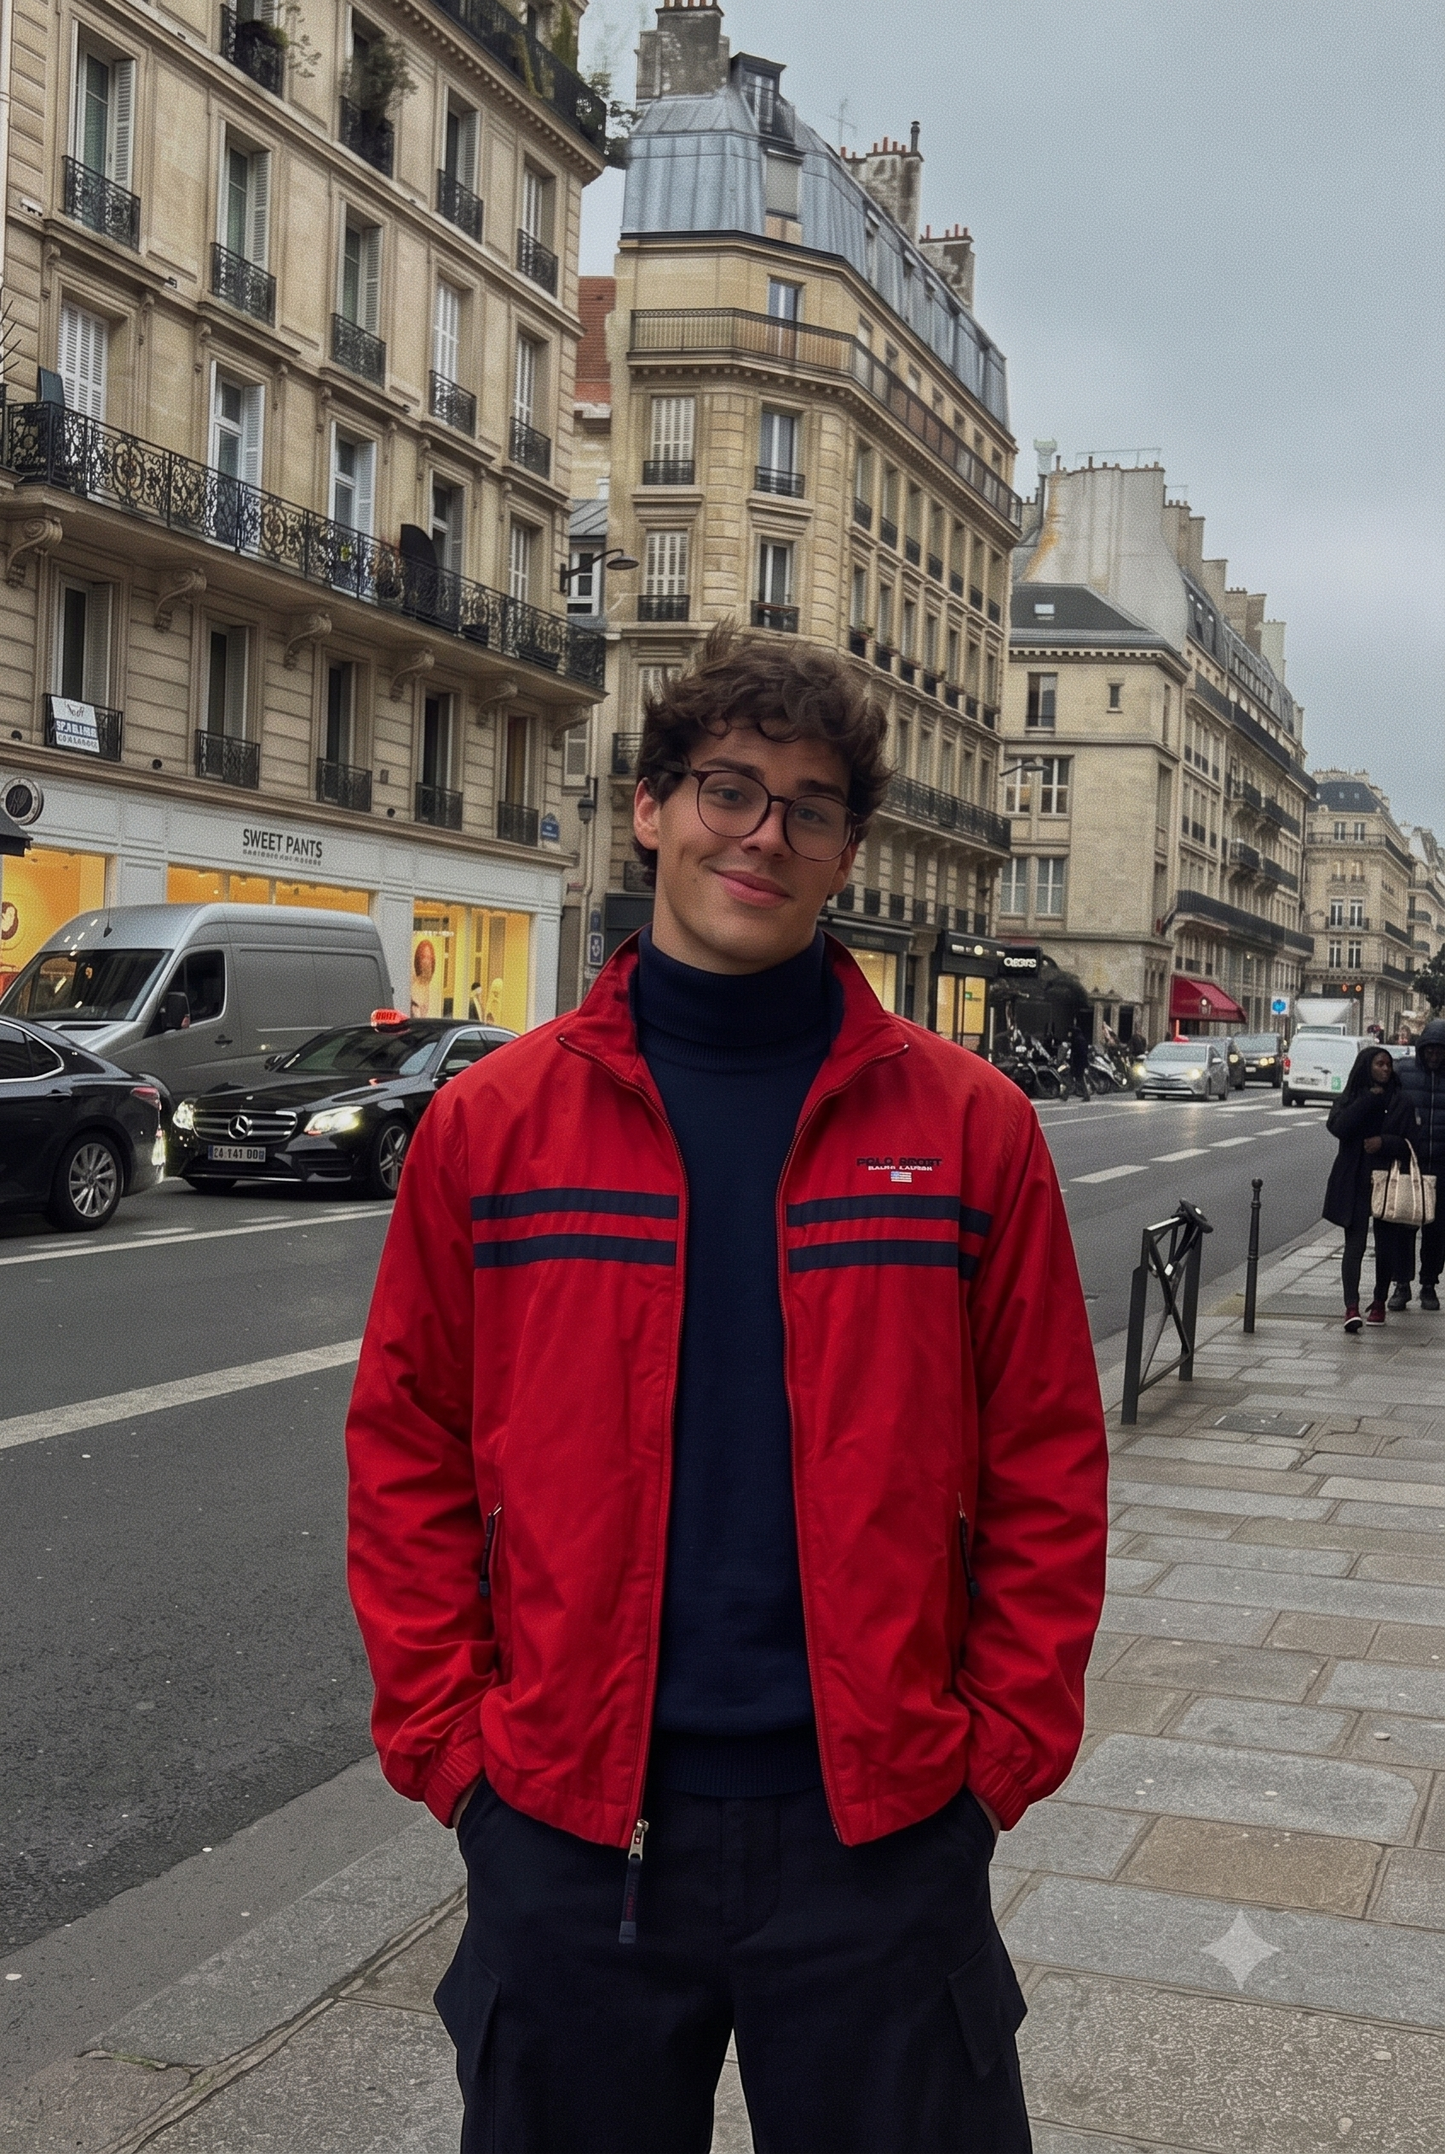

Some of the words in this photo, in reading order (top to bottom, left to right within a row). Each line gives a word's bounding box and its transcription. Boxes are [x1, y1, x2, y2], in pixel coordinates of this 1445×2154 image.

[243, 828, 283, 852] SWEET
[286, 836, 322, 858] PANTS
[857, 1157, 893, 1166] POLO
